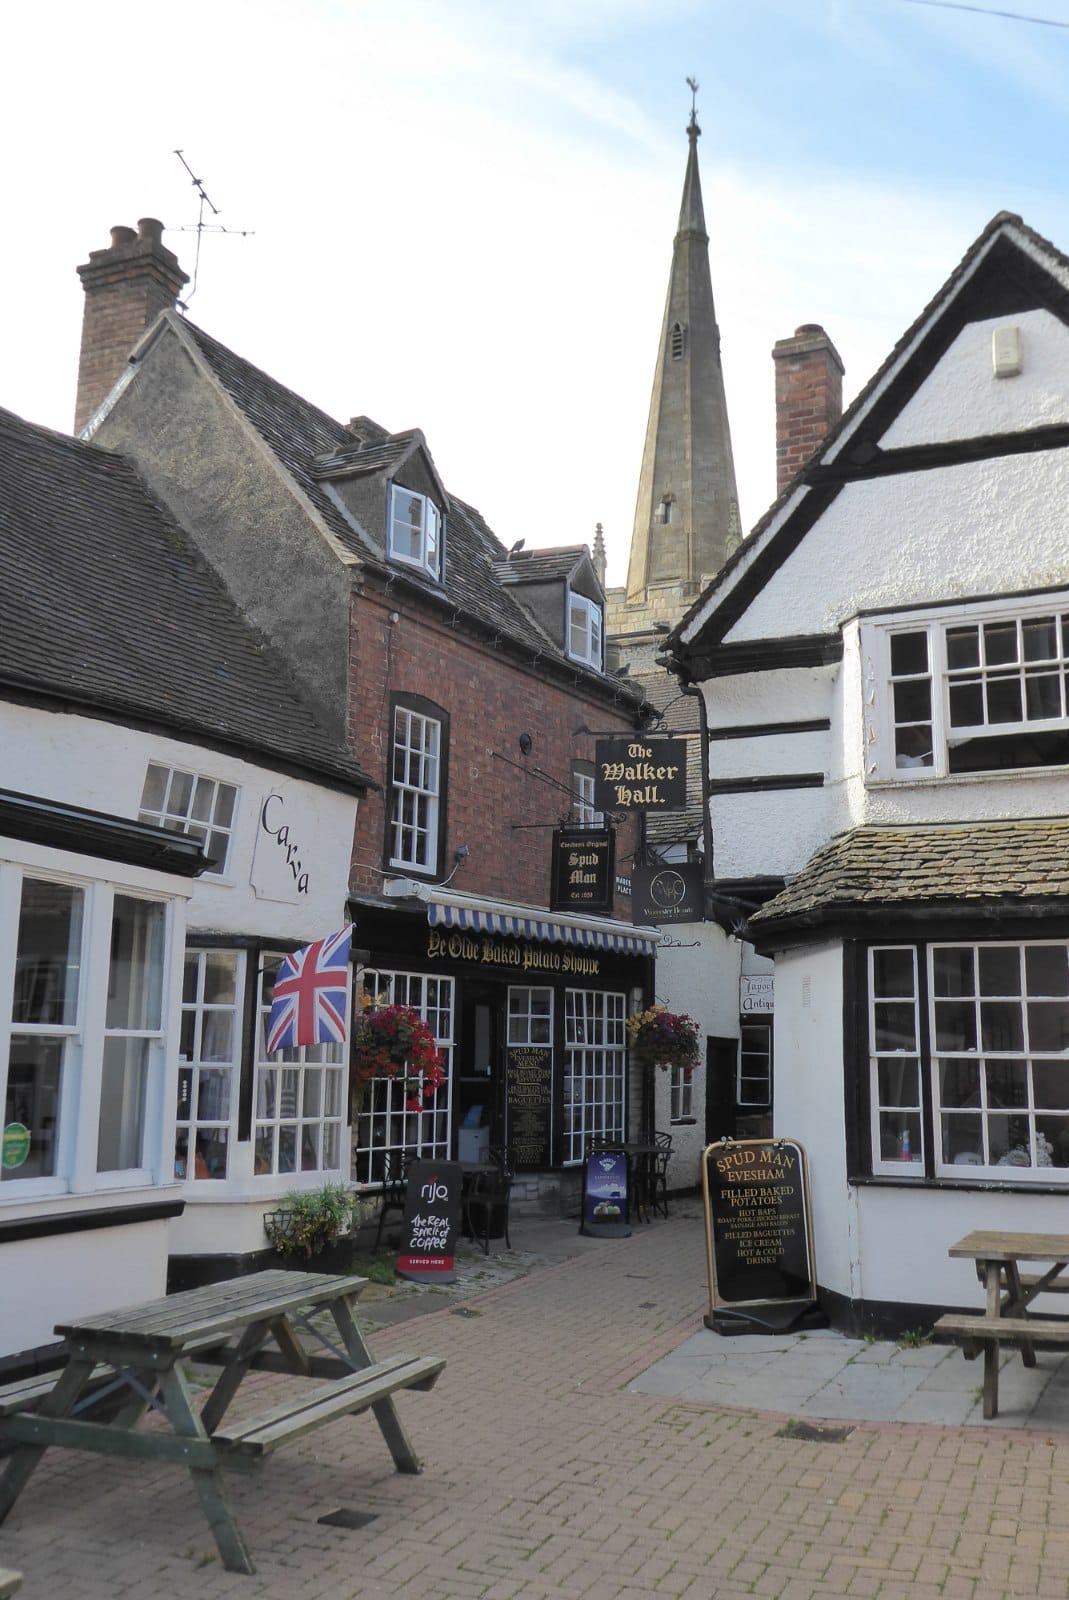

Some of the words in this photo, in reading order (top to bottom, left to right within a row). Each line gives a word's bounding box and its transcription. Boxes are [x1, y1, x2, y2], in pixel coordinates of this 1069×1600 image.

[627, 743, 653, 759] The
[601, 762, 679, 781] Walker
[261, 794, 310, 895] Carva
[567, 852, 599, 868] Spud
[568, 869, 597, 885] Man
[615, 876, 631, 887] MARKE
[427, 930, 447, 958] Ye
[448, 933, 480, 960] Olde
[481, 938, 521, 966] Baked
[522, 944, 561, 972] Potato
[562, 949, 600, 976] Shoppe
[743, 997, 774, 1011] Antiqu
[716, 1151, 756, 1173] SPUD
[759, 1150, 795, 1169] MAN
[727, 1169, 785, 1182] EVESHAM
[721, 1188, 758, 1199] FILLED
[759, 1186, 794, 1198] BAKED
[730, 1196, 784, 1208] POTATOES
[738, 1209, 756, 1217] HOT
[757, 1208, 777, 1216] BAPS
[724, 1231, 753, 1240] FILLED
[753, 1228, 796, 1239] BAGUETTES
[739, 1240, 753, 1248] ICE
[753, 1238, 782, 1247] CREAM
[737, 1249, 754, 1257] HOT
[762, 1247, 785, 1256] COLD
[746, 1256, 777, 1265] DRINKS
